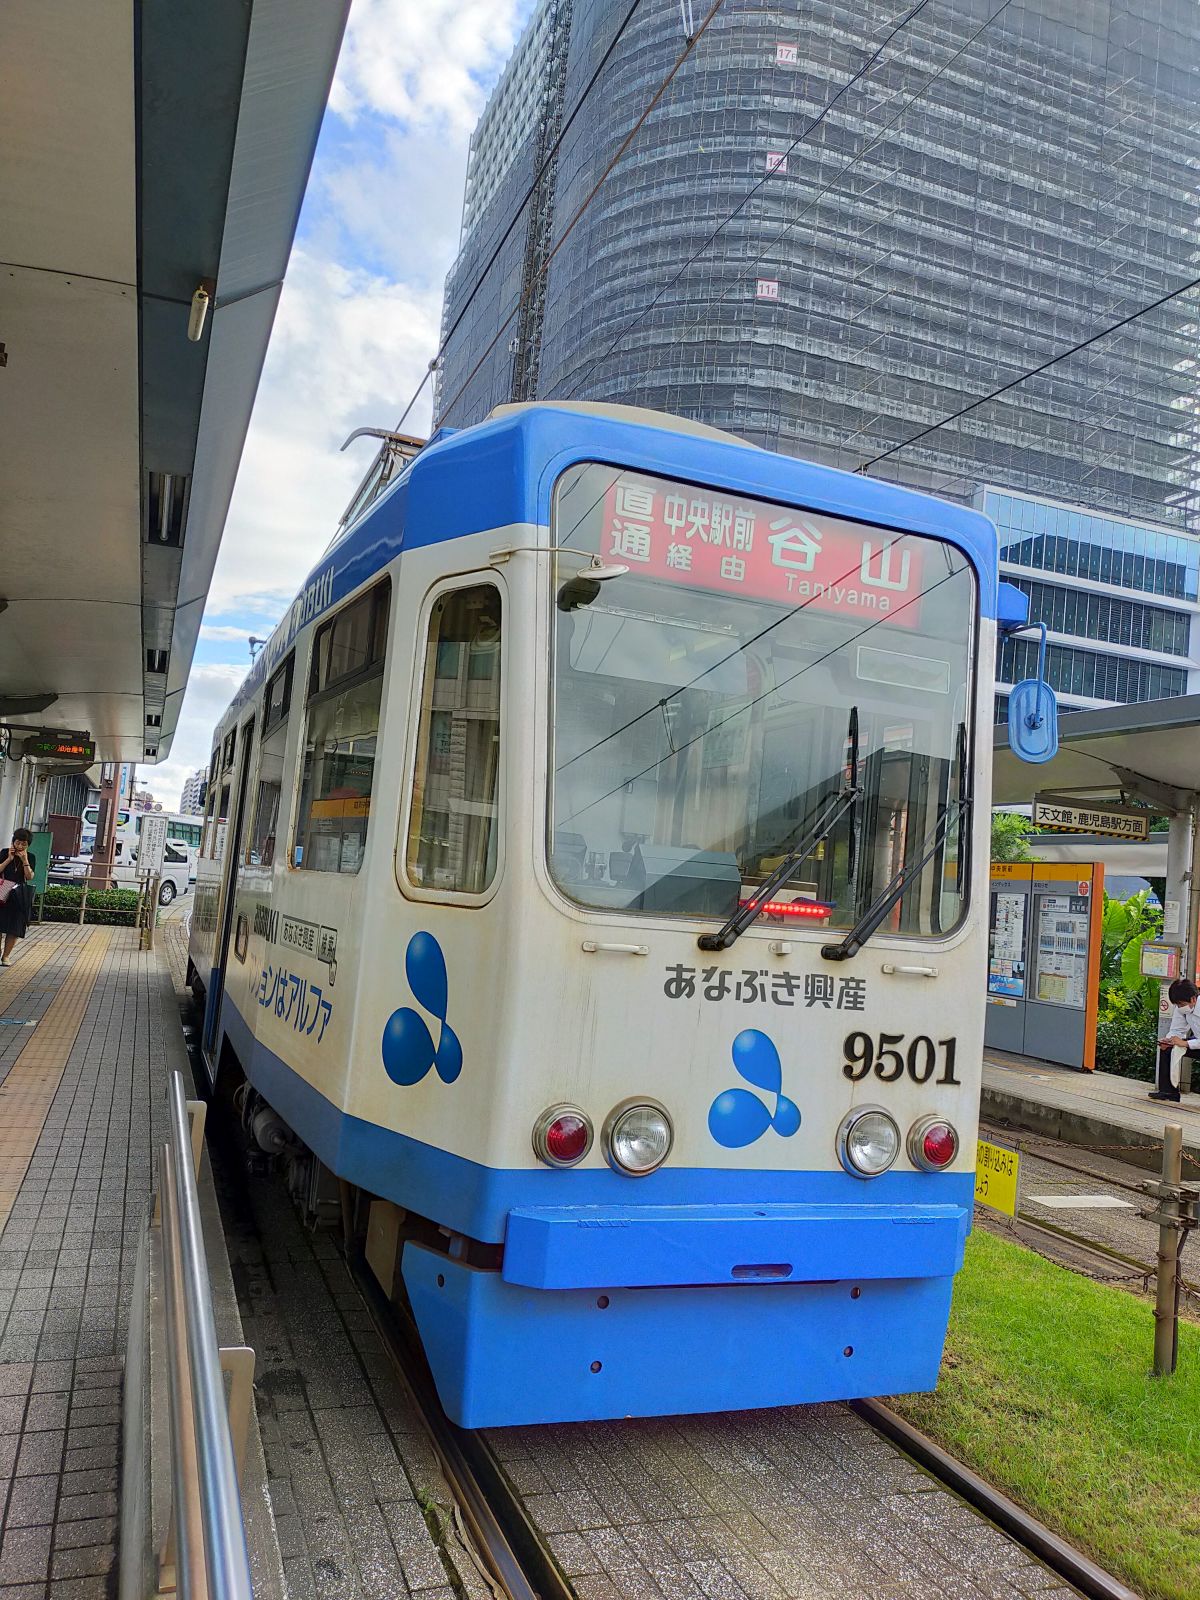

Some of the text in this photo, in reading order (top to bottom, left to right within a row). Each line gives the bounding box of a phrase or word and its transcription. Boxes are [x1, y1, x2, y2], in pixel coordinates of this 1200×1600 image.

[779, 48, 796, 61] 17F
[759, 283, 777, 296] 11F
[609, 480, 656, 563] 直通
[662, 493, 757, 553] 中央駅前
[665, 541, 746, 583] 経由
[767, 516, 911, 592] 谷山
[784, 571, 891, 611] Taniyama
[1038, 807, 1144, 834] 天文館・鹿児島駅方面
[663, 963, 867, 1012] あなぶき興産
[842, 1030, 962, 1086] 9501
